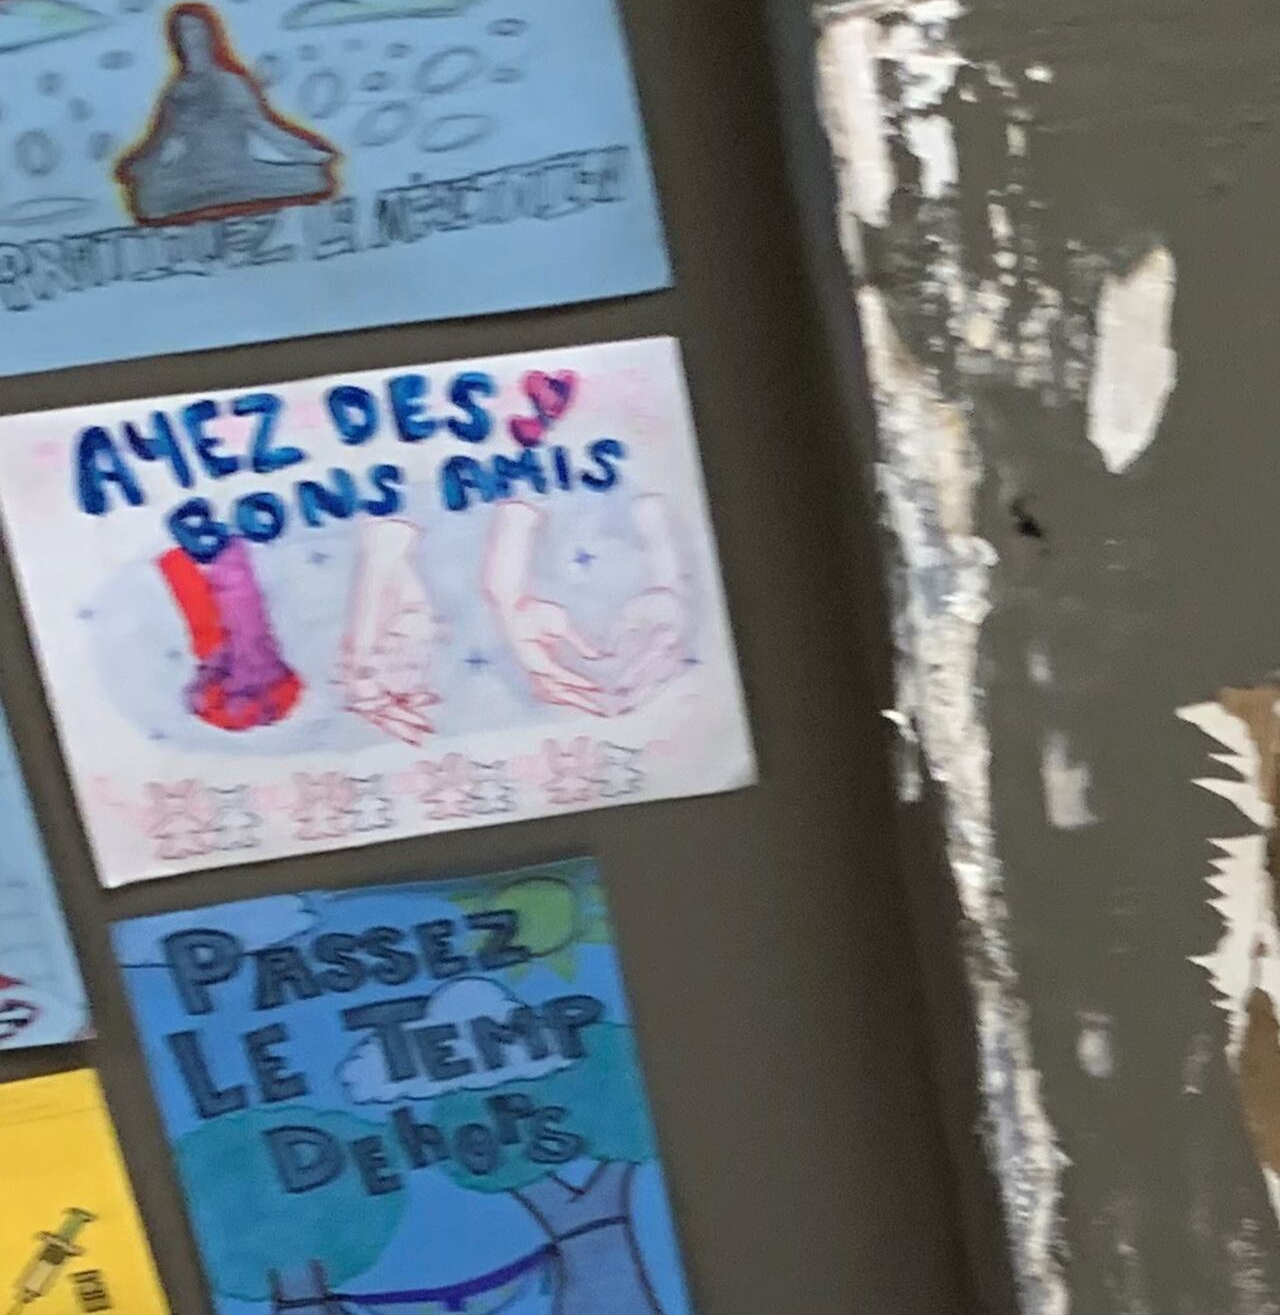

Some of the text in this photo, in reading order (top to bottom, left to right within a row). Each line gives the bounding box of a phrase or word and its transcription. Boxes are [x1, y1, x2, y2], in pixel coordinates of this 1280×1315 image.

[73, 372, 496, 516] AYEZ DES
[166, 438, 627, 563] BONS AMIS
[160, 909, 538, 1016] PASSEZ
[166, 994, 605, 1120] LE TEMP
